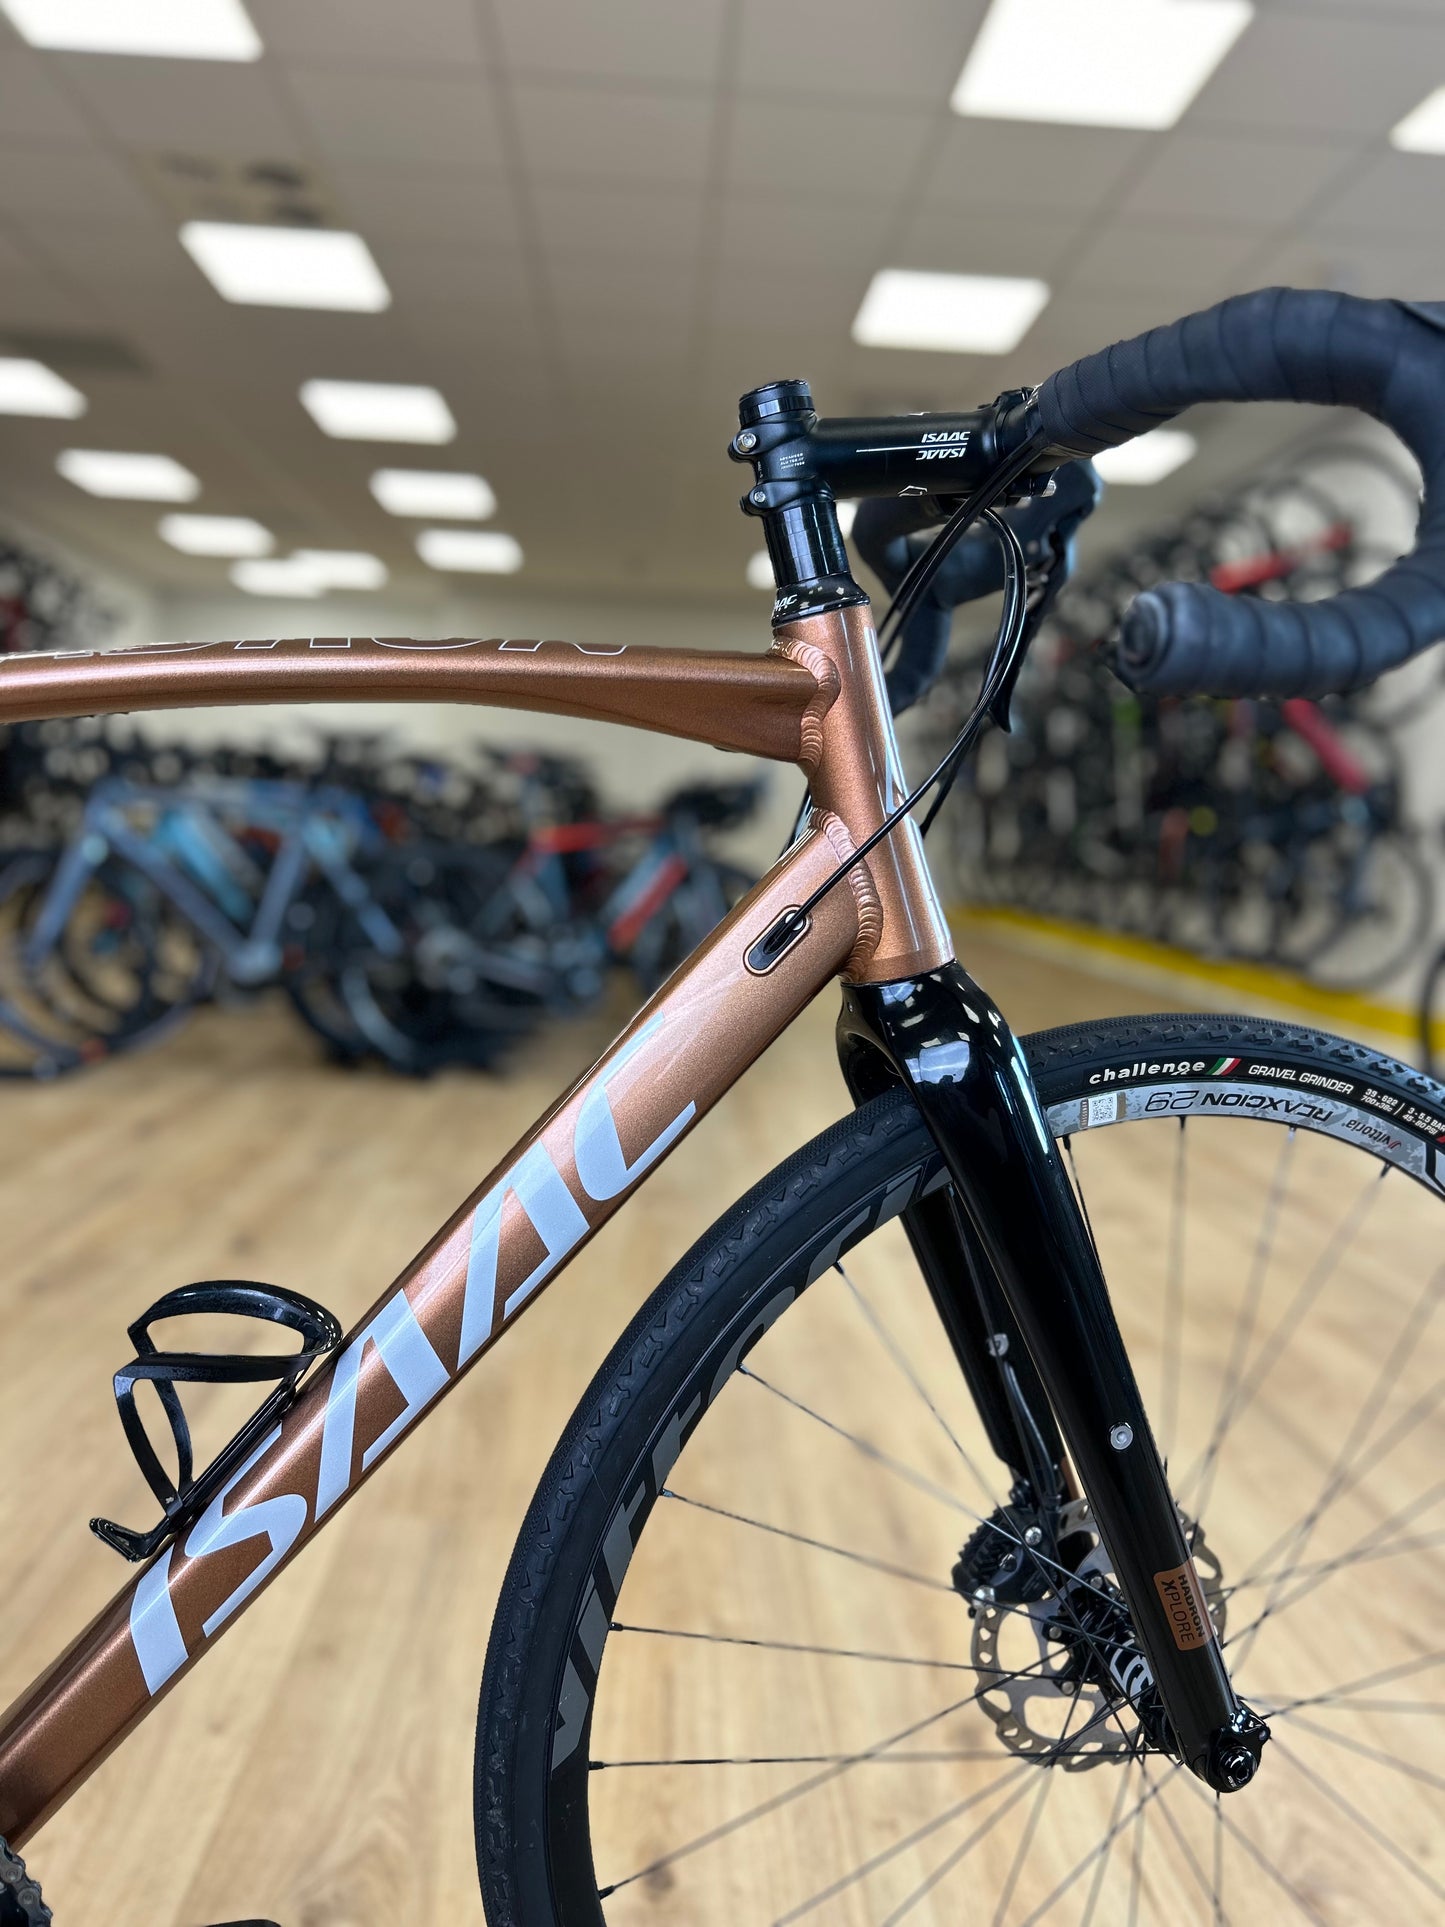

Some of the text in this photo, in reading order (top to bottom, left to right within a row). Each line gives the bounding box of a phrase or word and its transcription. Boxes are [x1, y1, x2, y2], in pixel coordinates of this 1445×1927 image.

[915, 447, 967, 460] ISAAC
[921, 432, 971, 443] ISAAC
[1088, 1061, 1354, 1095] challenge GRAVEL GRINDER
[1145, 1090, 1200, 1112] 29
[129, 1012, 696, 1697] ISAAC
[1161, 1580, 1195, 1642] XPLORE
[1178, 1574, 1205, 1637] HADRON
